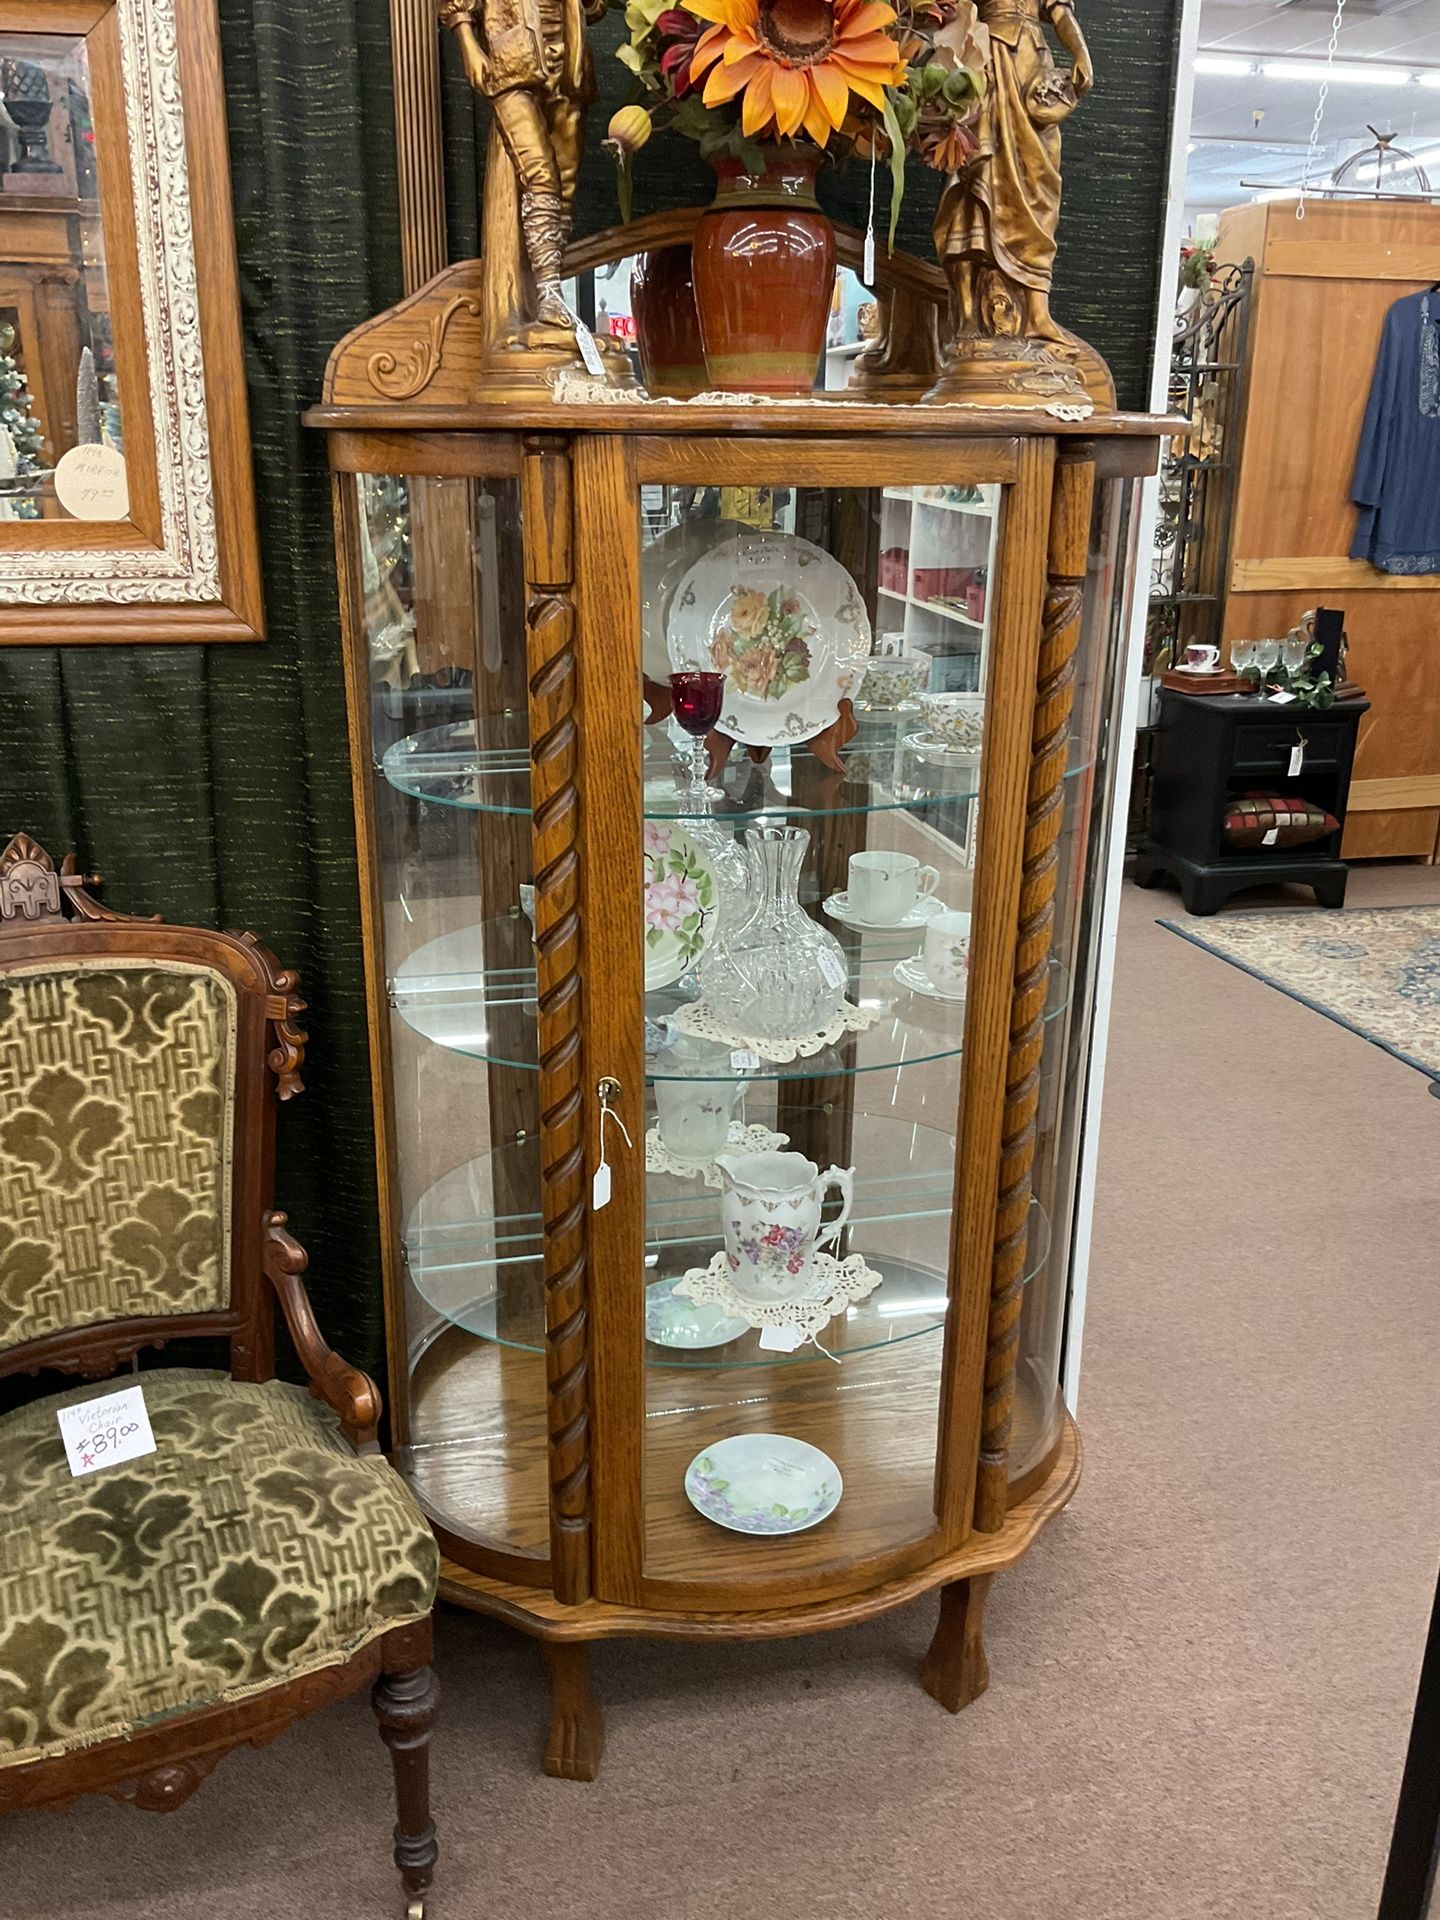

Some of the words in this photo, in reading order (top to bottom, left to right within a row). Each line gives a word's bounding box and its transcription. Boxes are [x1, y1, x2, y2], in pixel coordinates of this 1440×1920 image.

[79, 1402, 128, 1424] Victorian
[88, 1416, 123, 1434] Chair
[76, 1422, 139, 1454] $89.00
